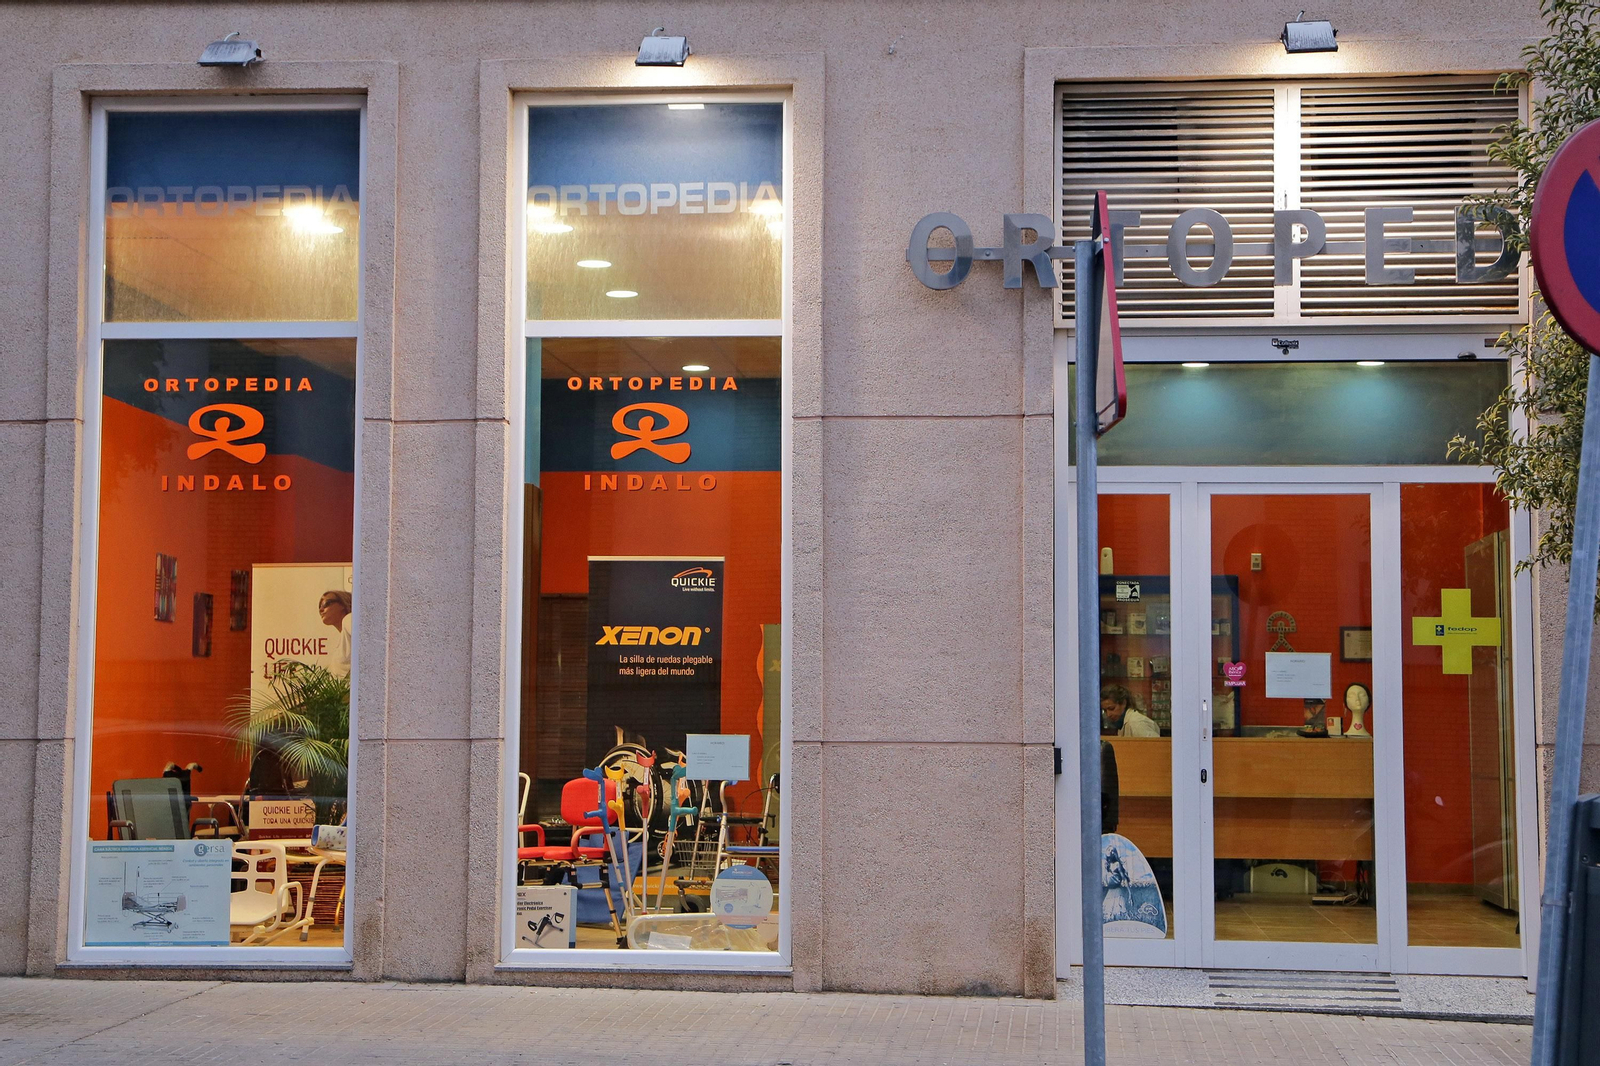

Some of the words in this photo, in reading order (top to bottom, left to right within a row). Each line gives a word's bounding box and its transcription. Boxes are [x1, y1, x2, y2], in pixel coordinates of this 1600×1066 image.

[105, 184, 359, 219] ORTOPEDIA
[527, 180, 782, 217] ORTOPEDIA
[143, 376, 314, 393] ORTOPEDIA
[566, 375, 739, 392] ORTOPEDIA
[160, 473, 292, 492] INDALO
[583, 473, 718, 492] INDALO
[671, 577, 716, 588] QUICKIE
[264, 637, 328, 660] QUICKIE
[619, 655, 628, 664] La
[629, 655, 645, 664] silla
[646, 655, 655, 664] de
[656, 655, 681, 664] ruedas
[682, 655, 713, 666] plegable
[619, 667, 634, 676] más
[636, 667, 656, 677] ligera
[657, 667, 669, 675] del
[670, 667, 695, 676] mundo
[262, 806, 291, 816] QUICKIE
[195, 844, 225, 856] gersa
